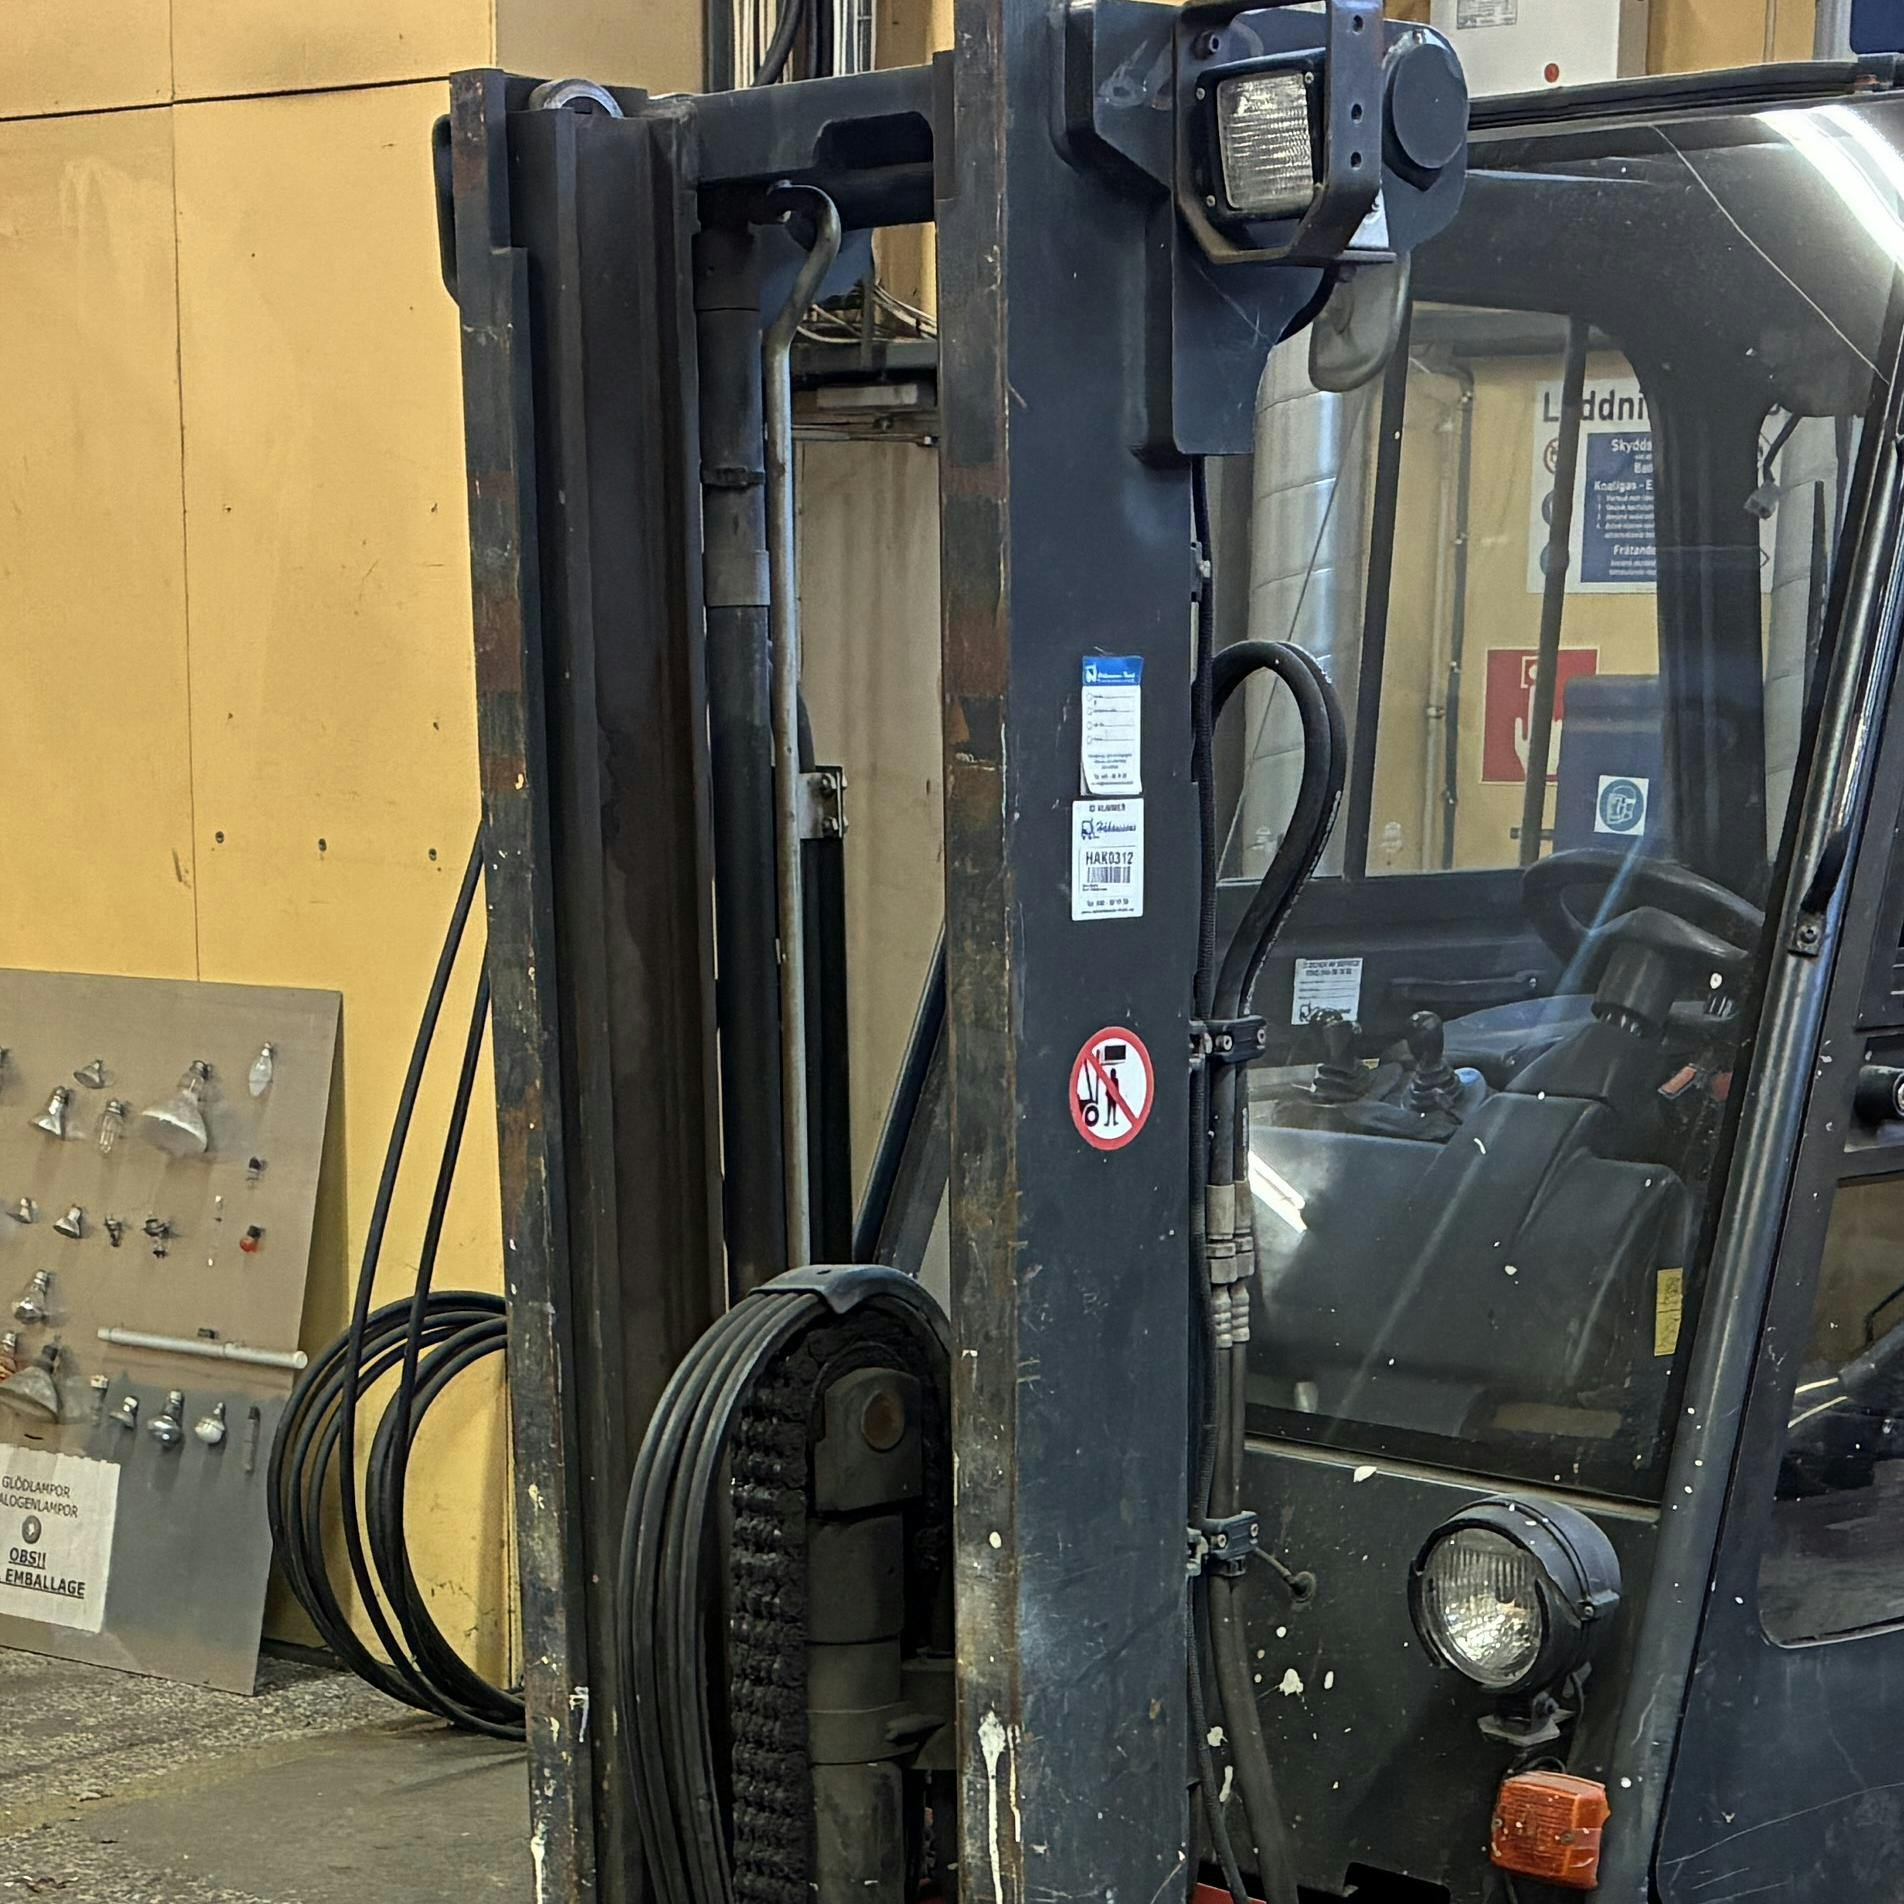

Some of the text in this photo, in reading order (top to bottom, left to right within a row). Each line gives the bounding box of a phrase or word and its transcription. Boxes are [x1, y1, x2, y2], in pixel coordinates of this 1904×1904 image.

[1085, 851, 1134, 866] HAK0312
[1, 1475, 71, 1499] GLÖDLAMPOR
[5, 1568, 86, 1598] EMBALLAGE
